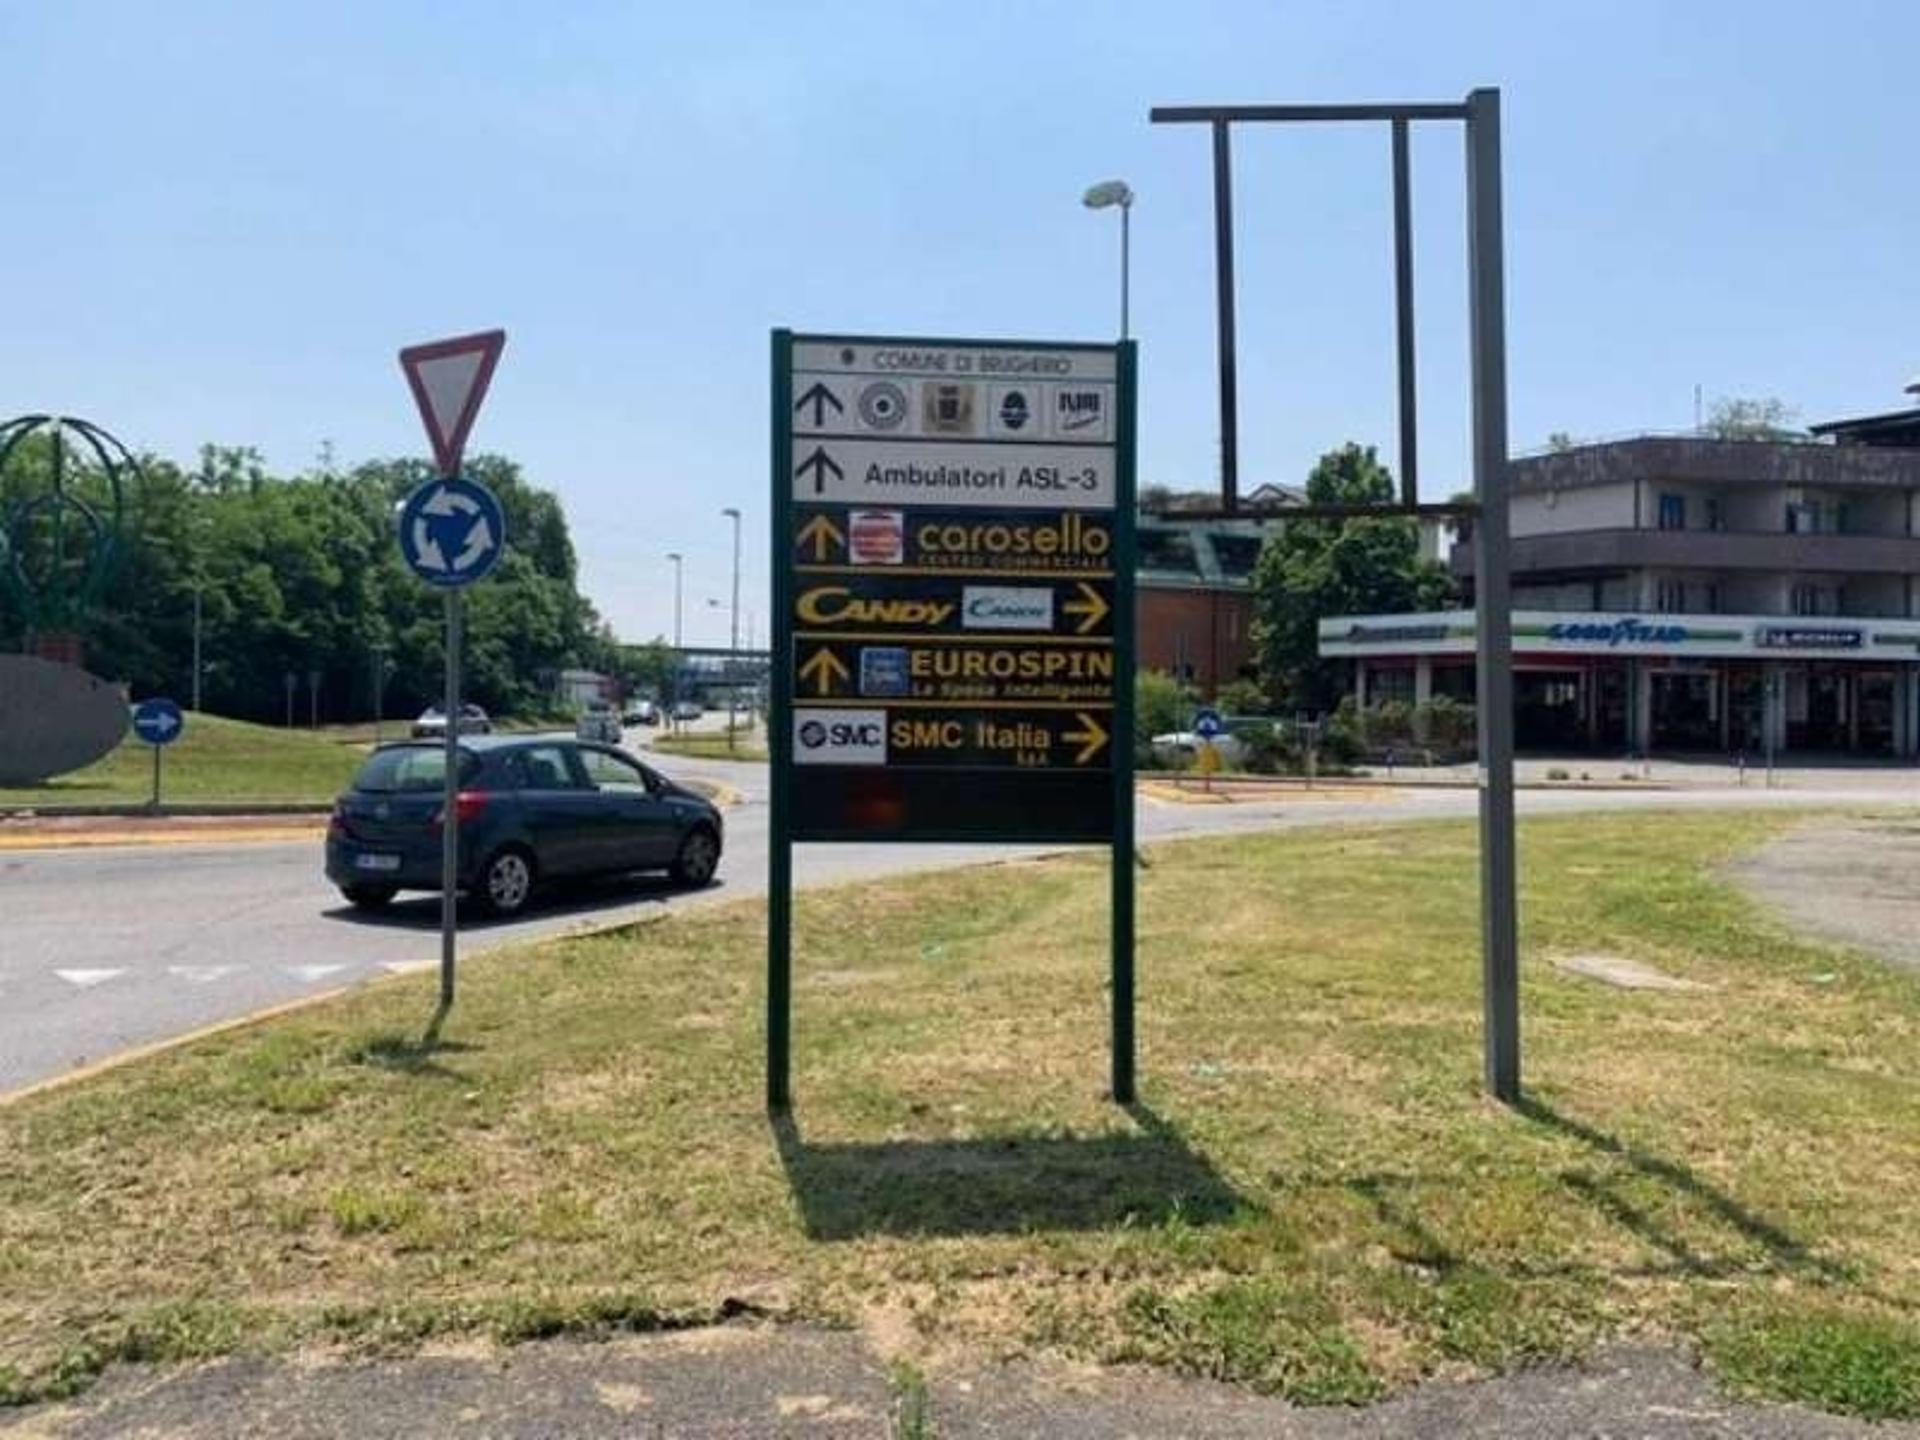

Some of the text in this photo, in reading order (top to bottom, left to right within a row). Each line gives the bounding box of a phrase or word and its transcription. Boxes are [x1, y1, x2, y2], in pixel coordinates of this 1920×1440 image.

[872, 351, 946, 371] COMUNE
[955, 354, 972, 372] DI
[864, 463, 1098, 491] Ambulatori ASL-3
[917, 513, 1110, 556] carosello
[795, 586, 954, 624] CANDY
[910, 650, 1113, 677] EUROSPIN
[830, 721, 881, 747] SMC
[891, 721, 1050, 748] SMC Italia
